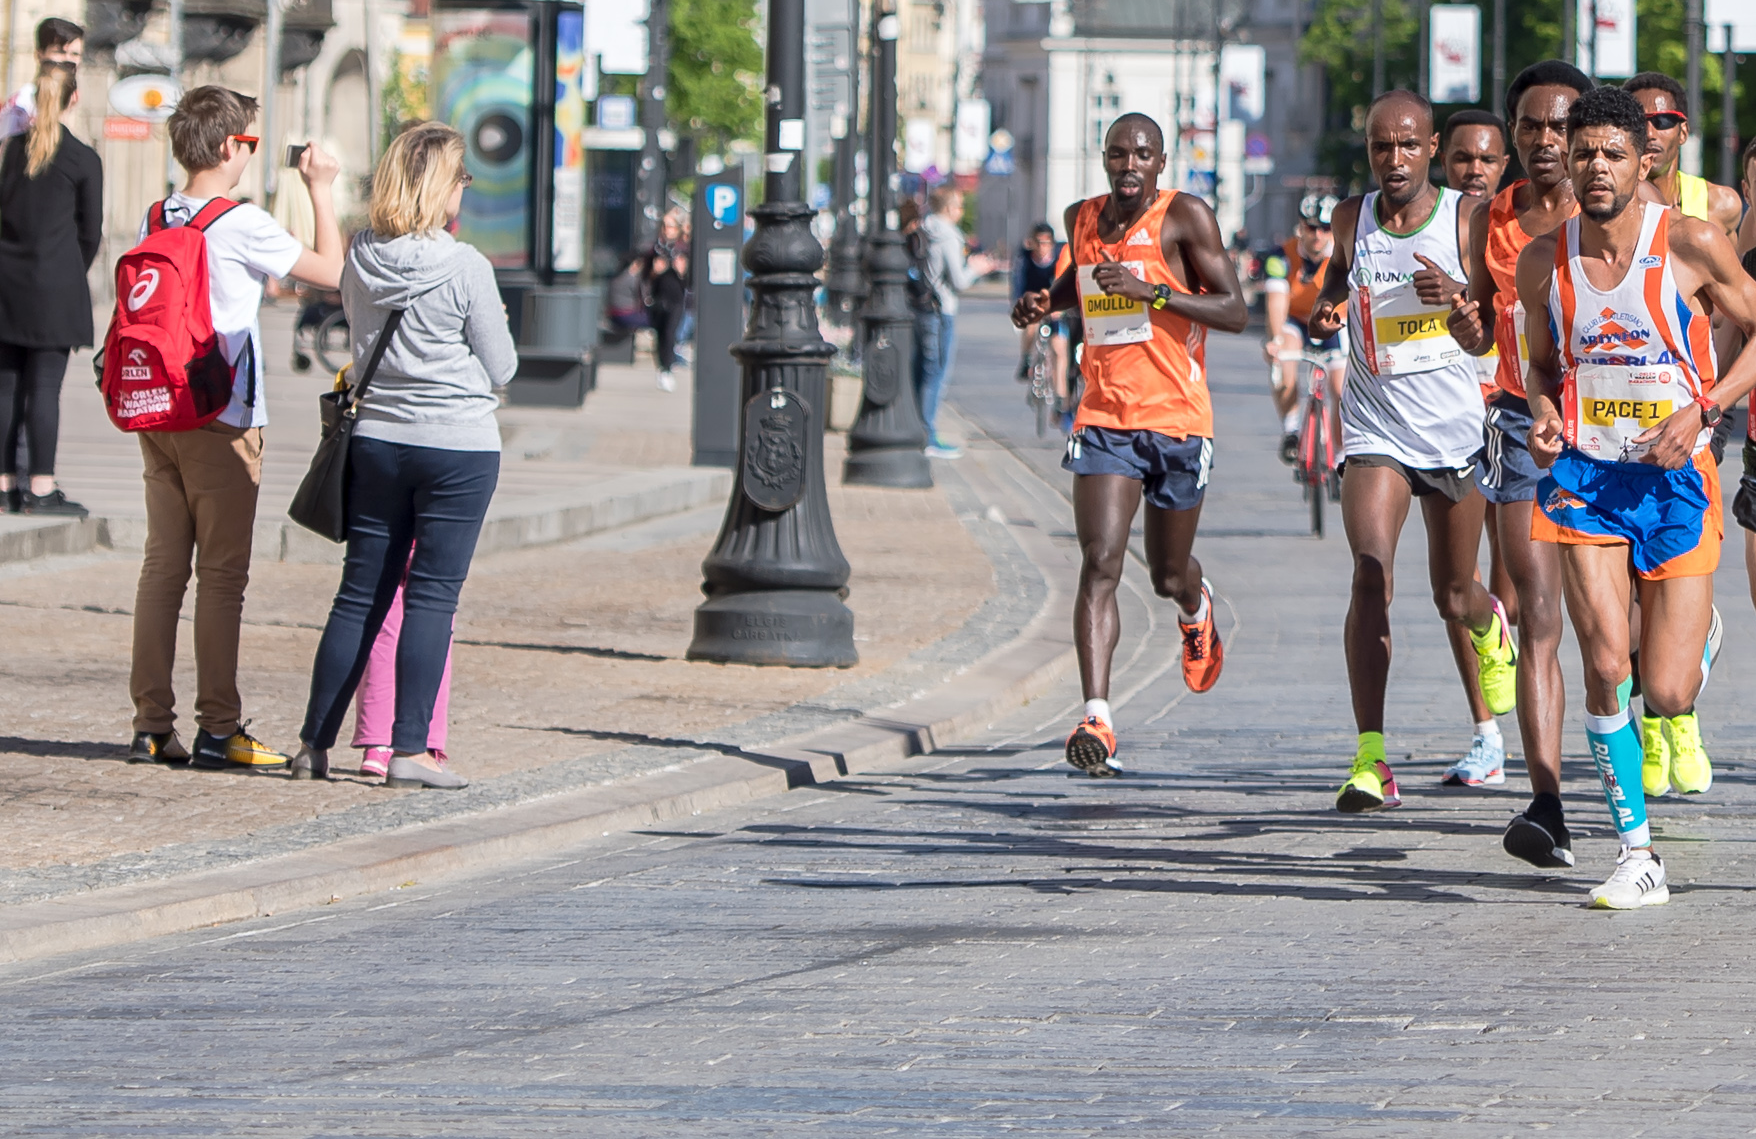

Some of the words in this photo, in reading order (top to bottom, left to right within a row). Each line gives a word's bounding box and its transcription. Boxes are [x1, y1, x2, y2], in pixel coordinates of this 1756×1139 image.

[714, 186, 736, 219] P
[1088, 298, 1134, 312] OMULLO
[1397, 318, 1437, 336] TOLA
[124, 393, 170, 409] WARSAW
[132, 386, 167, 400] ORLEN
[1593, 401, 1643, 418] PACE
[1649, 403, 1660, 419] 1
